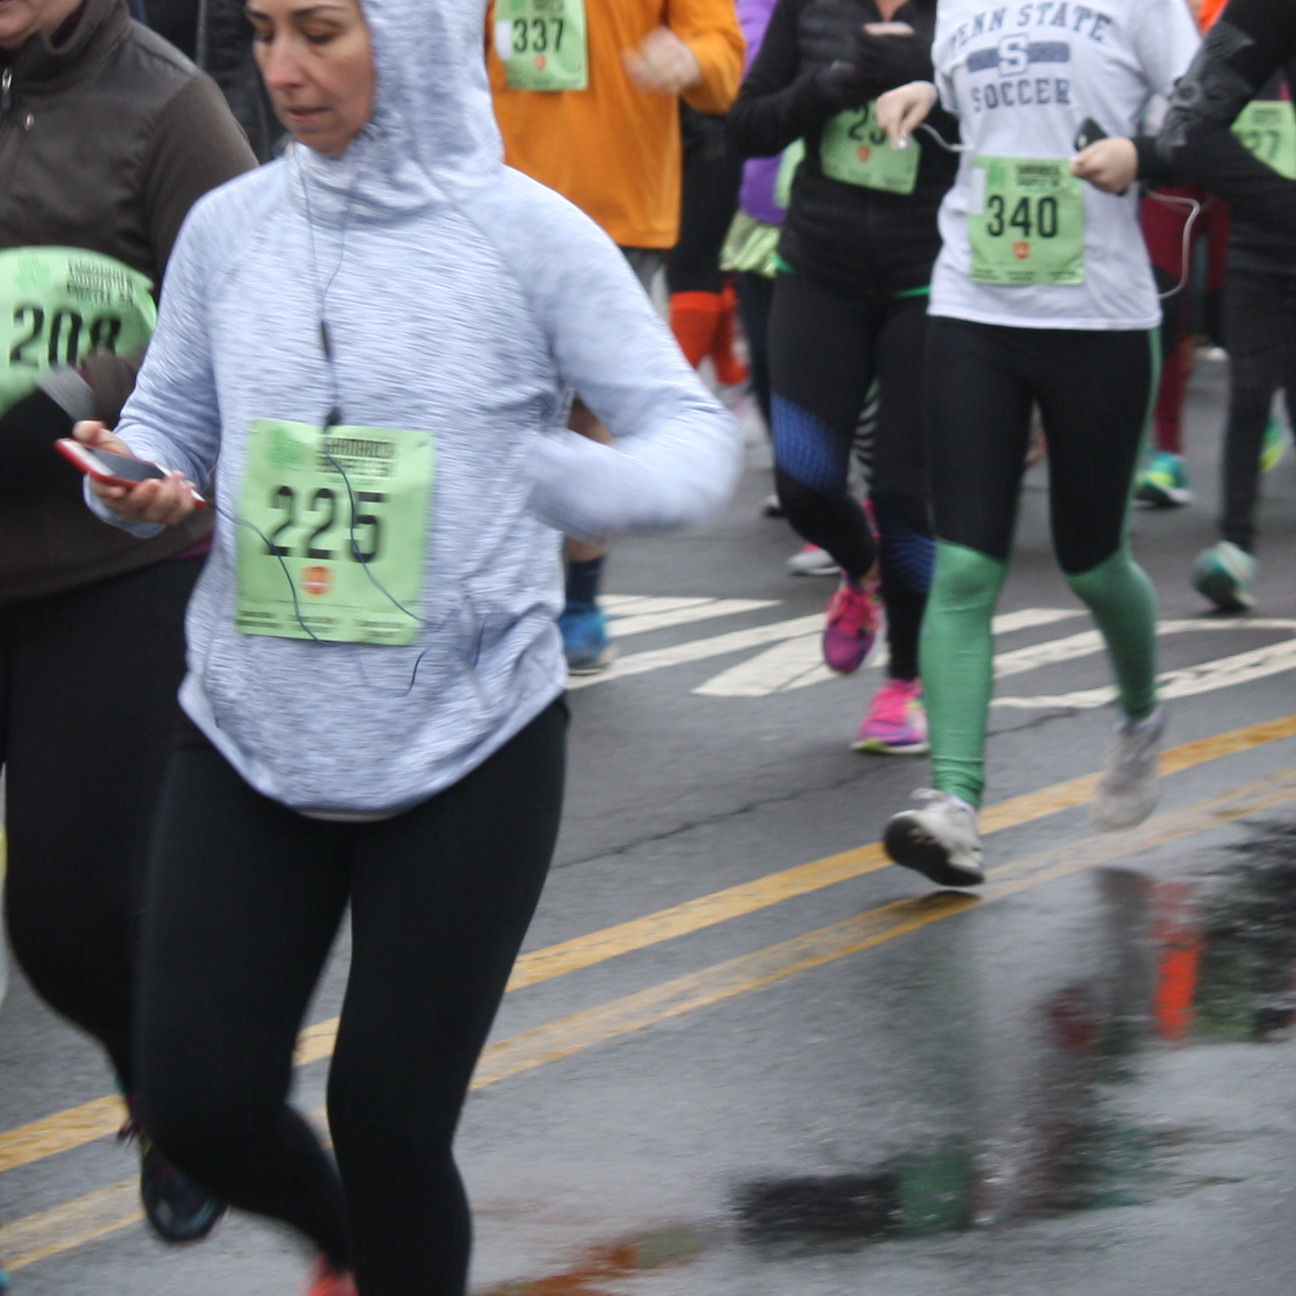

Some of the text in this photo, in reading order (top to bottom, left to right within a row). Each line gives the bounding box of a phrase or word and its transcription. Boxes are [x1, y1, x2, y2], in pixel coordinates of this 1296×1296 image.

[512, 17, 565, 55] 337
[1016, 1, 1113, 42] STATE
[970, 77, 1072, 114] SOCCER
[986, 194, 1059, 240] 340
[264, 483, 390, 564] 225
